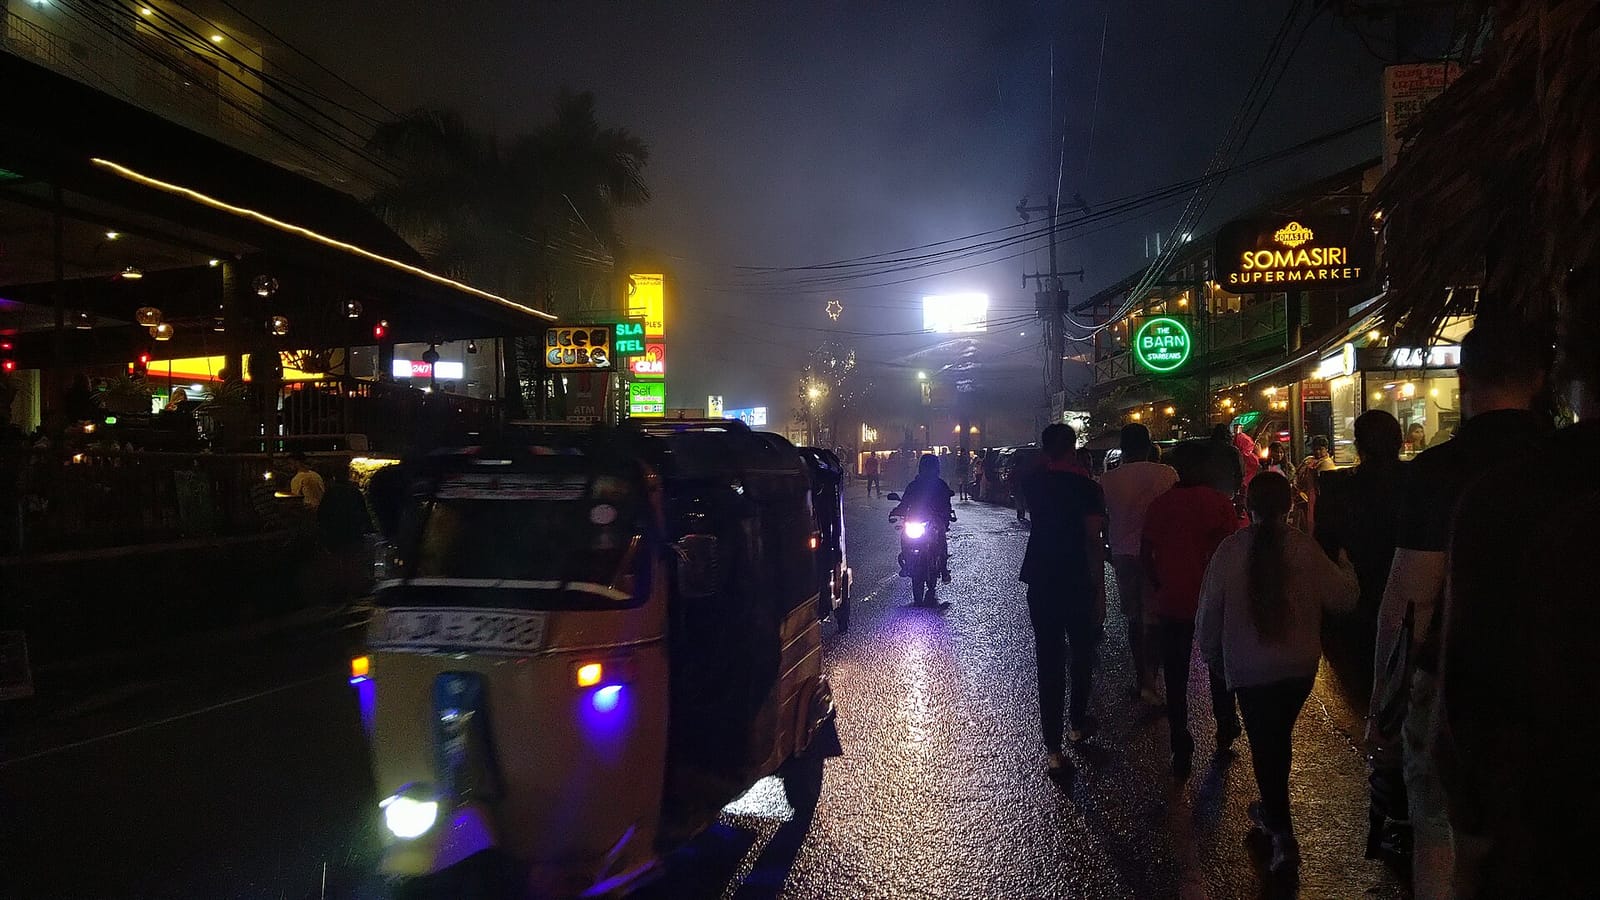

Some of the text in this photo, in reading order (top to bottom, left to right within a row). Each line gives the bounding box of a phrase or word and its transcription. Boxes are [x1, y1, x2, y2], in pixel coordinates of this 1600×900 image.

[1274, 232, 1314, 242] SOMASIRI
[1243, 248, 1347, 269] SOMASIRI
[1230, 267, 1361, 284] SUPERMARKET
[1143, 335, 1185, 348] BARN
[1147, 352, 1181, 360] STARBEANS
[412, 364, 429, 373] 24/7
[574, 406, 595, 415] ATM
